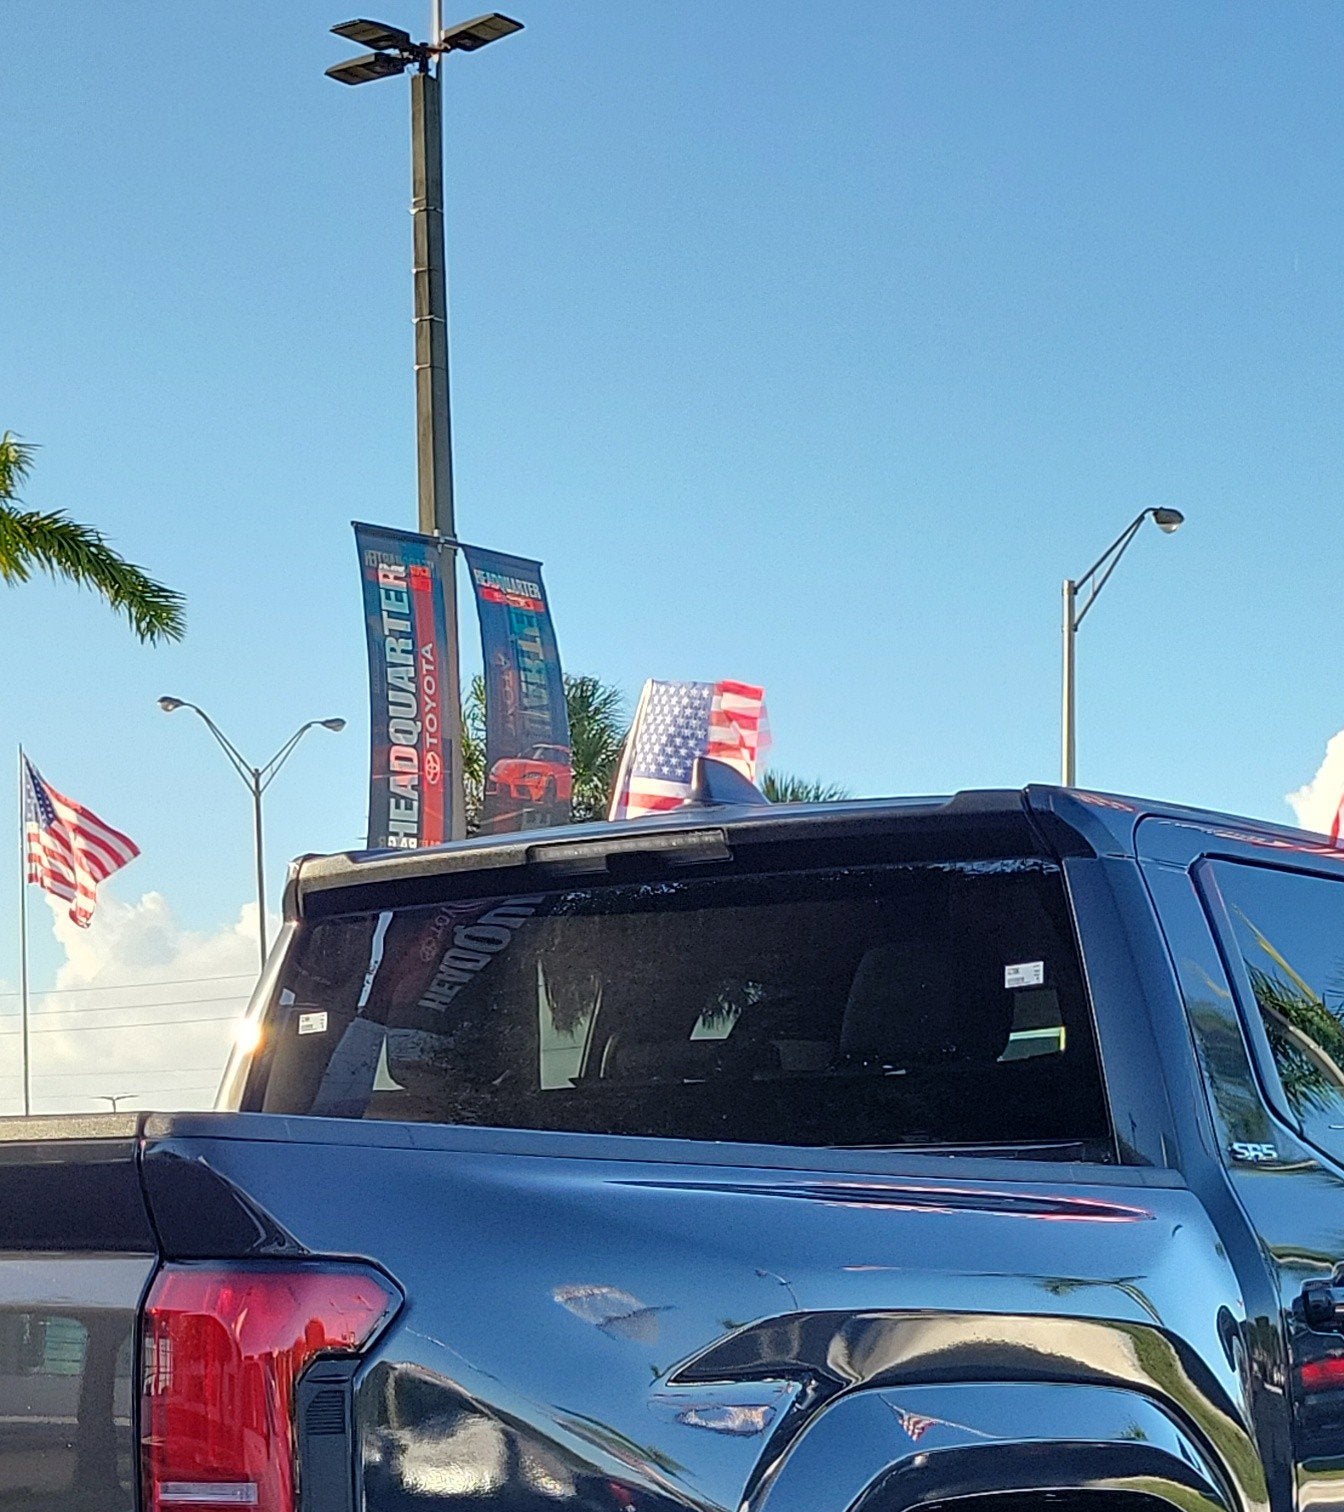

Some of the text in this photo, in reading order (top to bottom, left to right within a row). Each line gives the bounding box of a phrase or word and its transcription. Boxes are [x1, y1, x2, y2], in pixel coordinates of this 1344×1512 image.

[377, 562, 422, 849] HEADQUARTER
[420, 643, 438, 748] TOYOTA
[1232, 1142, 1278, 1161] SR5
